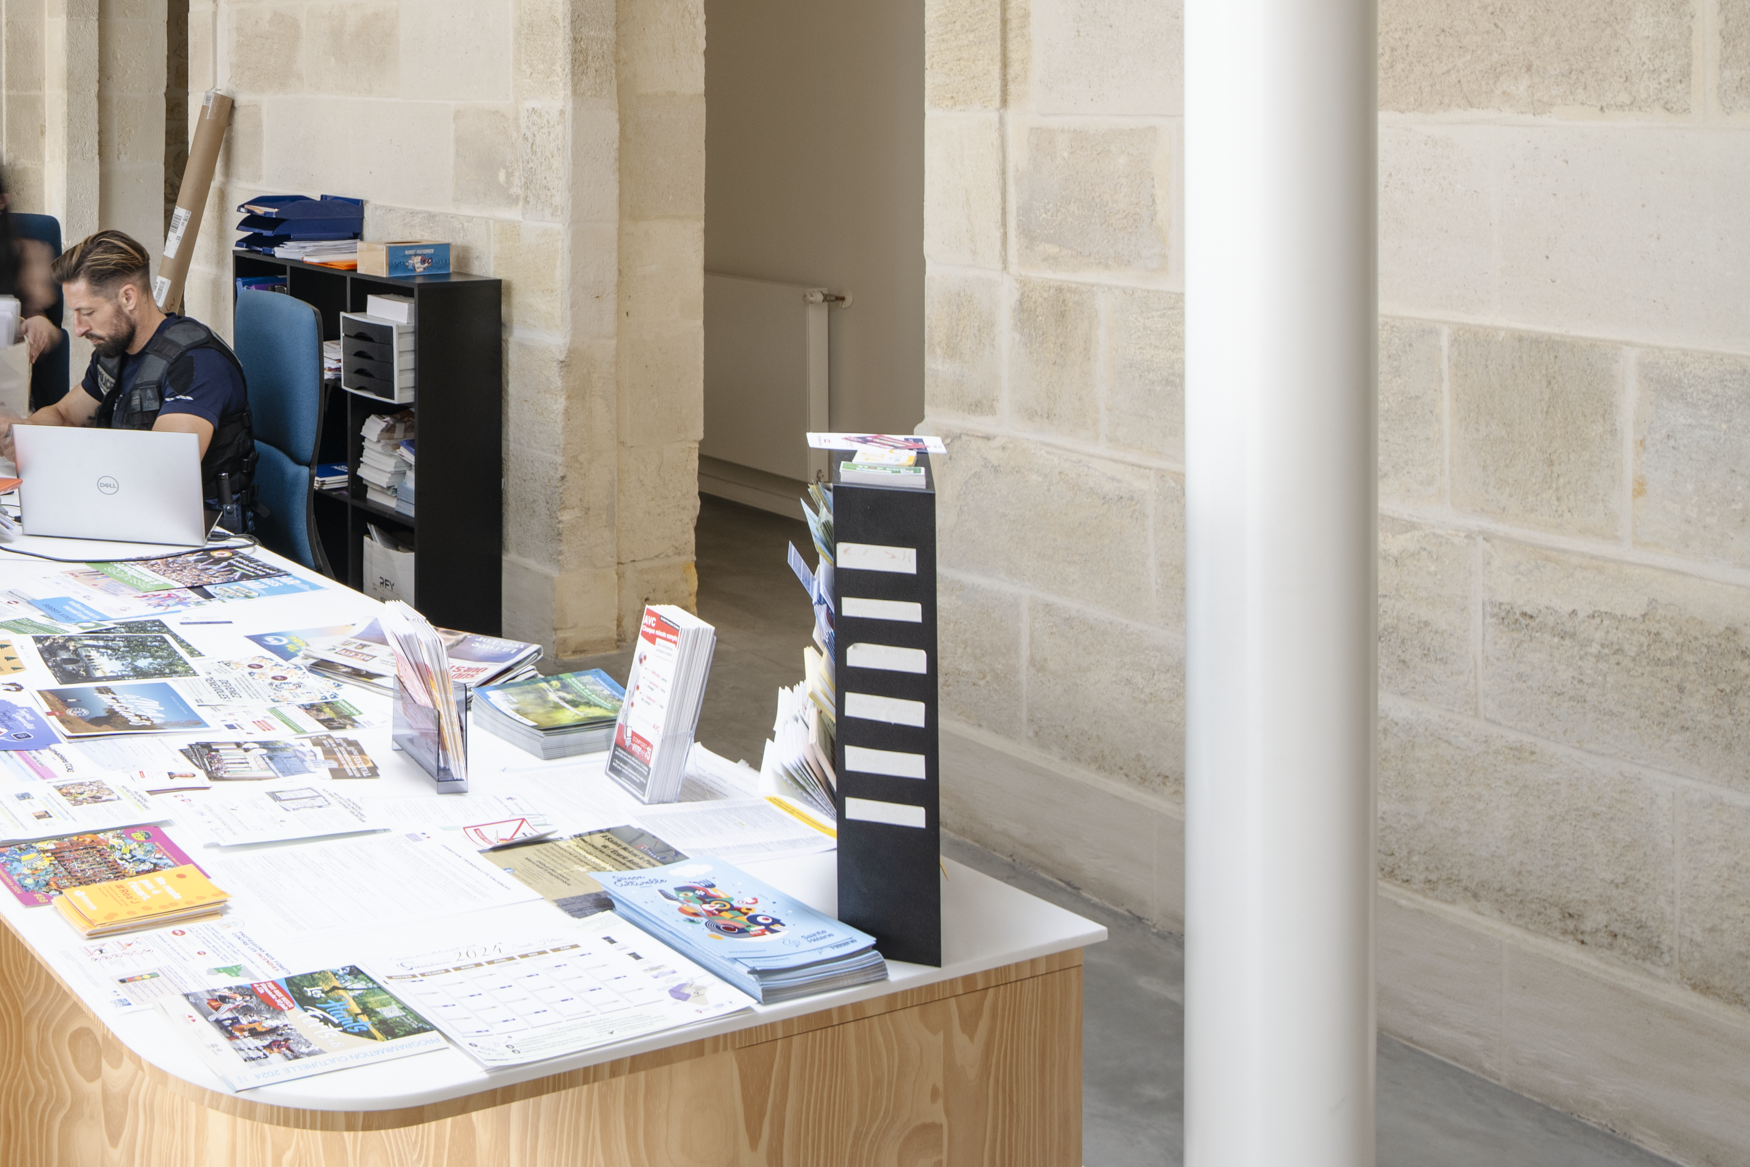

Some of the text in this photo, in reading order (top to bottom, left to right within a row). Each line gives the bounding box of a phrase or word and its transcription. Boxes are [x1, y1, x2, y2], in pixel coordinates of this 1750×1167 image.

[644, 615, 656, 627] AVC
[471, 642, 499, 652] ruée
[111, 883, 143, 904] #Réa'J
[136, 878, 158, 890] pas
[151, 876, 183, 899] Ne reste
[453, 944, 501, 962] 2024
[300, 984, 331, 999] Les
[293, 1005, 344, 1039] Forts
[314, 995, 375, 1033] Hauts
[252, 1036, 445, 1079] PROGRAMMATION CULTURELLE 2024
